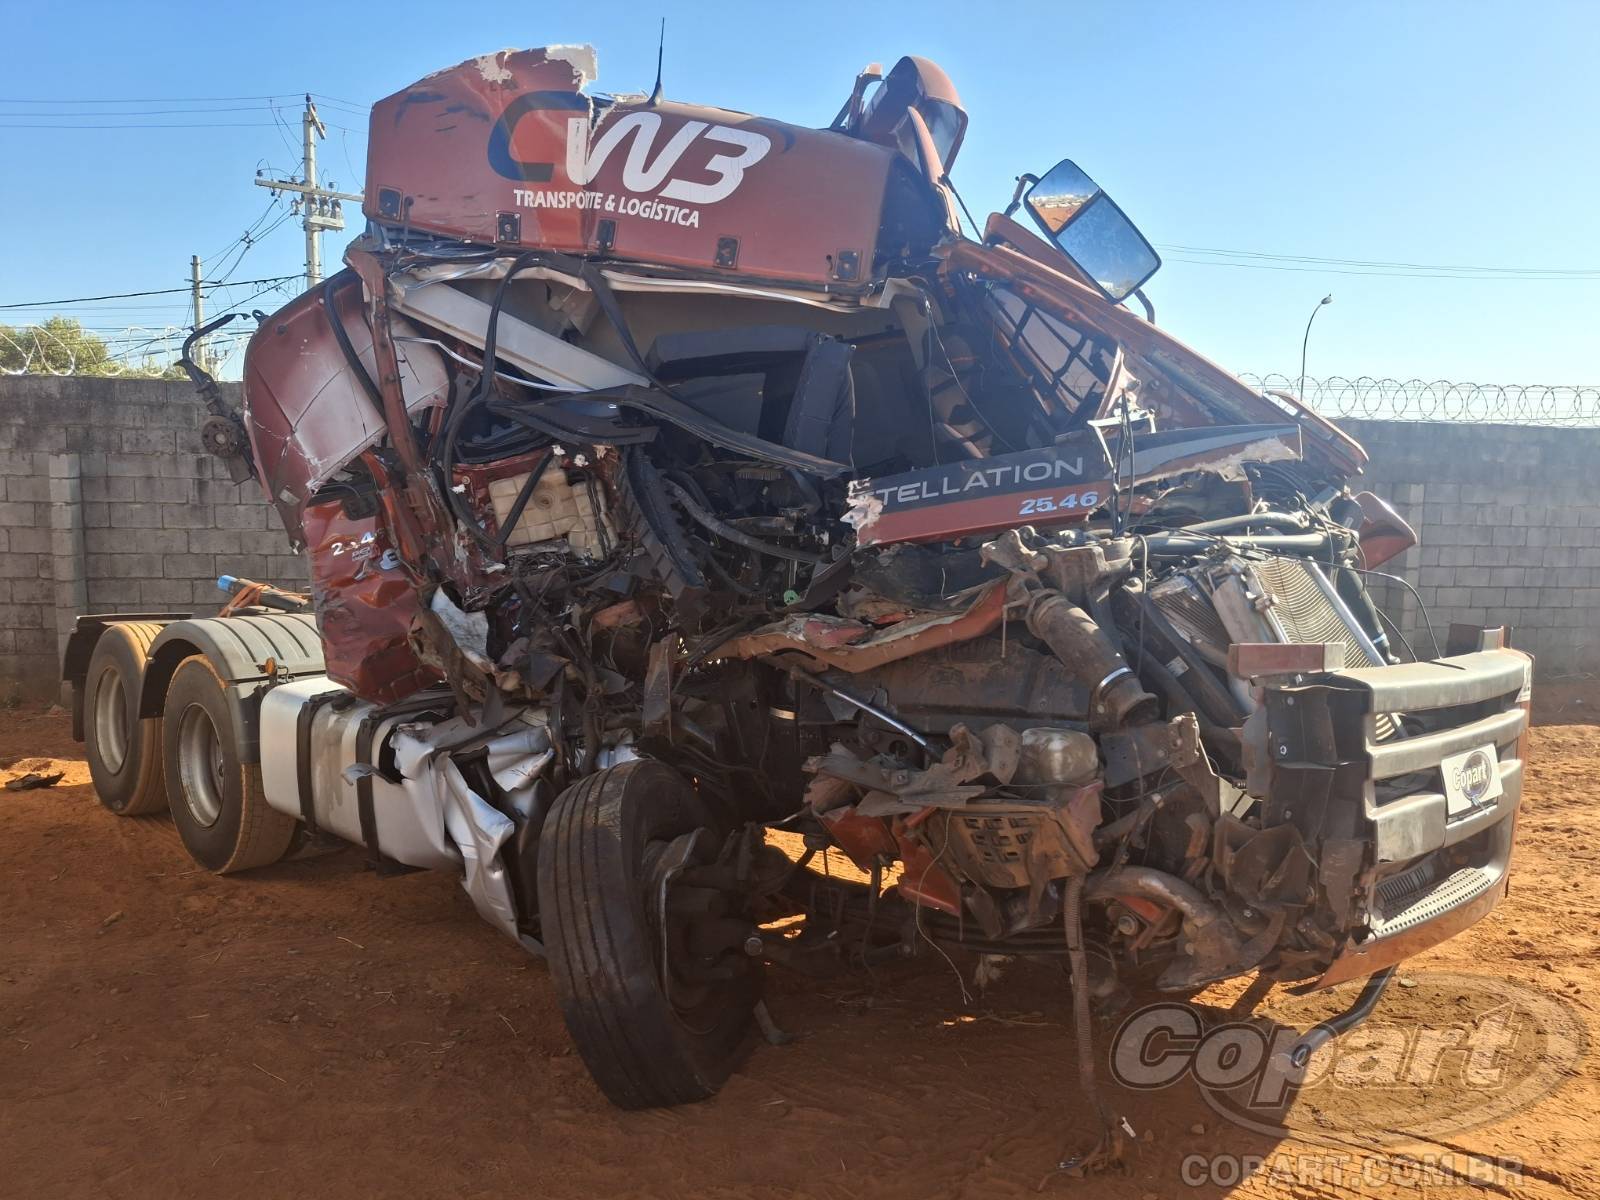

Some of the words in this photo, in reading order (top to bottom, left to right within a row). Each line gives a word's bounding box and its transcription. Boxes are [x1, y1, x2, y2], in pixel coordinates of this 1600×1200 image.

[487, 90, 771, 204] CW3
[513, 188, 604, 210] TRANSPORTE
[604, 194, 616, 212] &
[617, 198, 700, 229] LOGÍSTICA
[1019, 491, 1099, 515] 25.46
[1452, 759, 1488, 792] Copart
